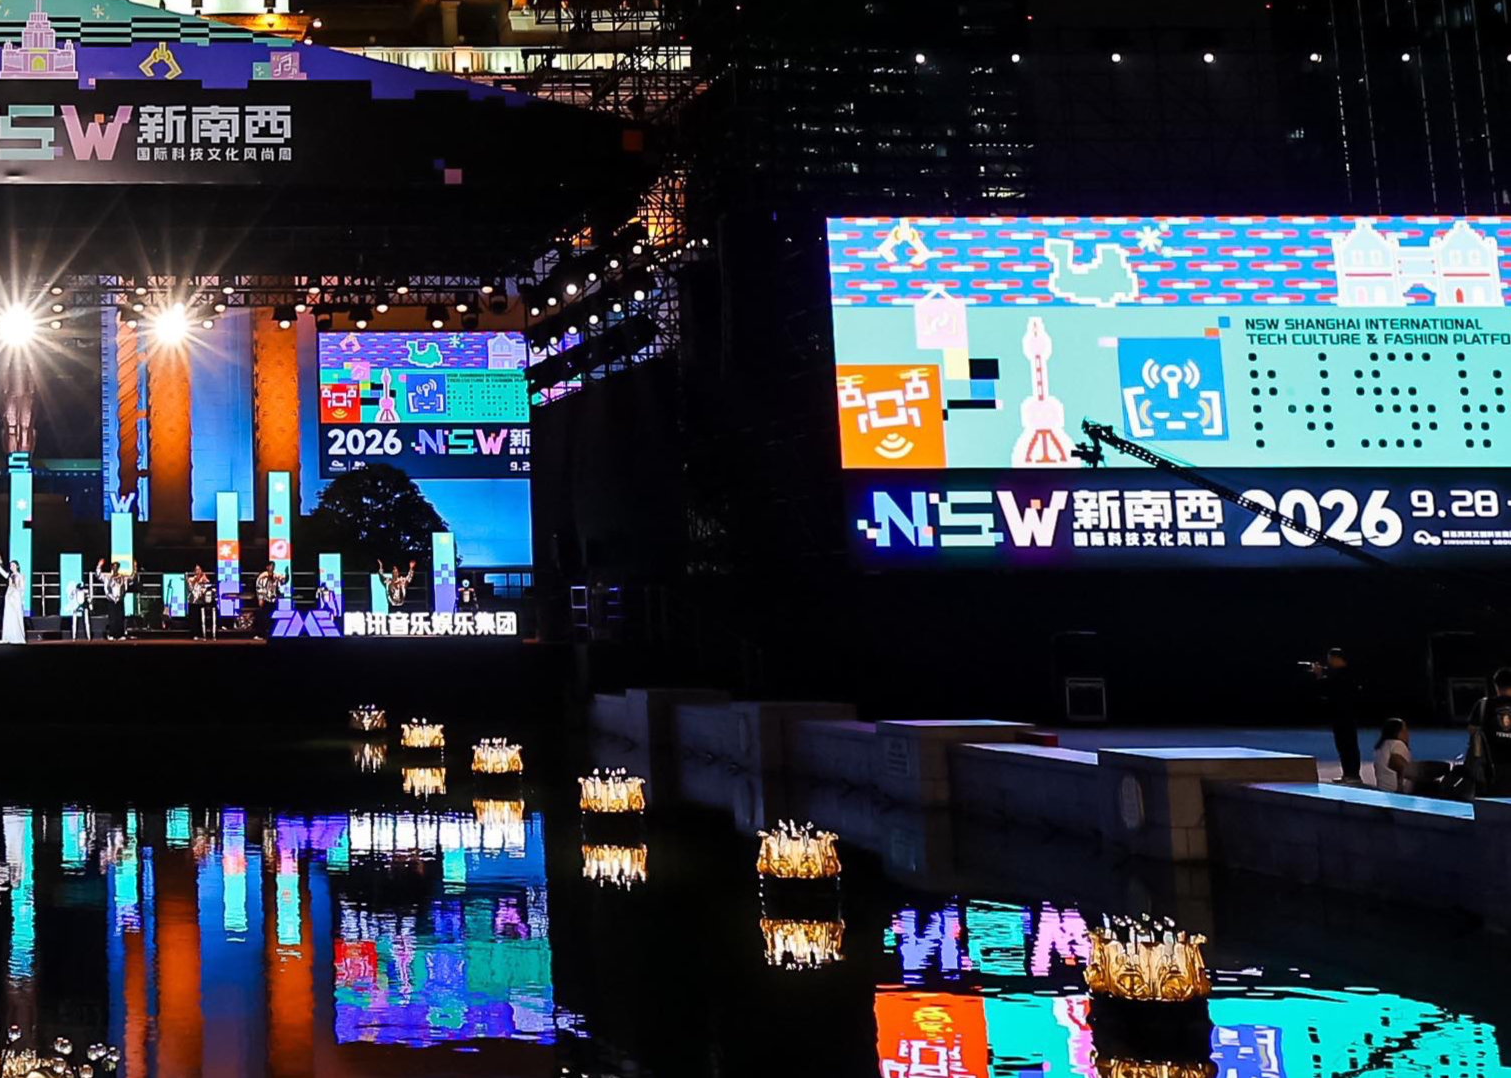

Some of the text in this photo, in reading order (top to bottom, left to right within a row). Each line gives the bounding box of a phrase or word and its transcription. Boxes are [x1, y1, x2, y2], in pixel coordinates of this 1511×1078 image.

[136, 105, 292, 144] 新南西
[136, 147, 292, 162] 国际科技文化风尚周
[1245, 318, 1483, 330] NSW SHANGHAI INTERNATIONAL
[1247, 333, 1288, 345] TECH
[1292, 333, 1361, 345] CULTURE
[1367, 333, 1378, 345] &
[1384, 333, 1449, 345] FASHION
[327, 428, 403, 455] 2026
[410, 429, 508, 455] NSW
[858, 489, 1403, 547] NSW 新南西 2026
[344, 611, 517, 635] 腾讯音乐娱乐集团
